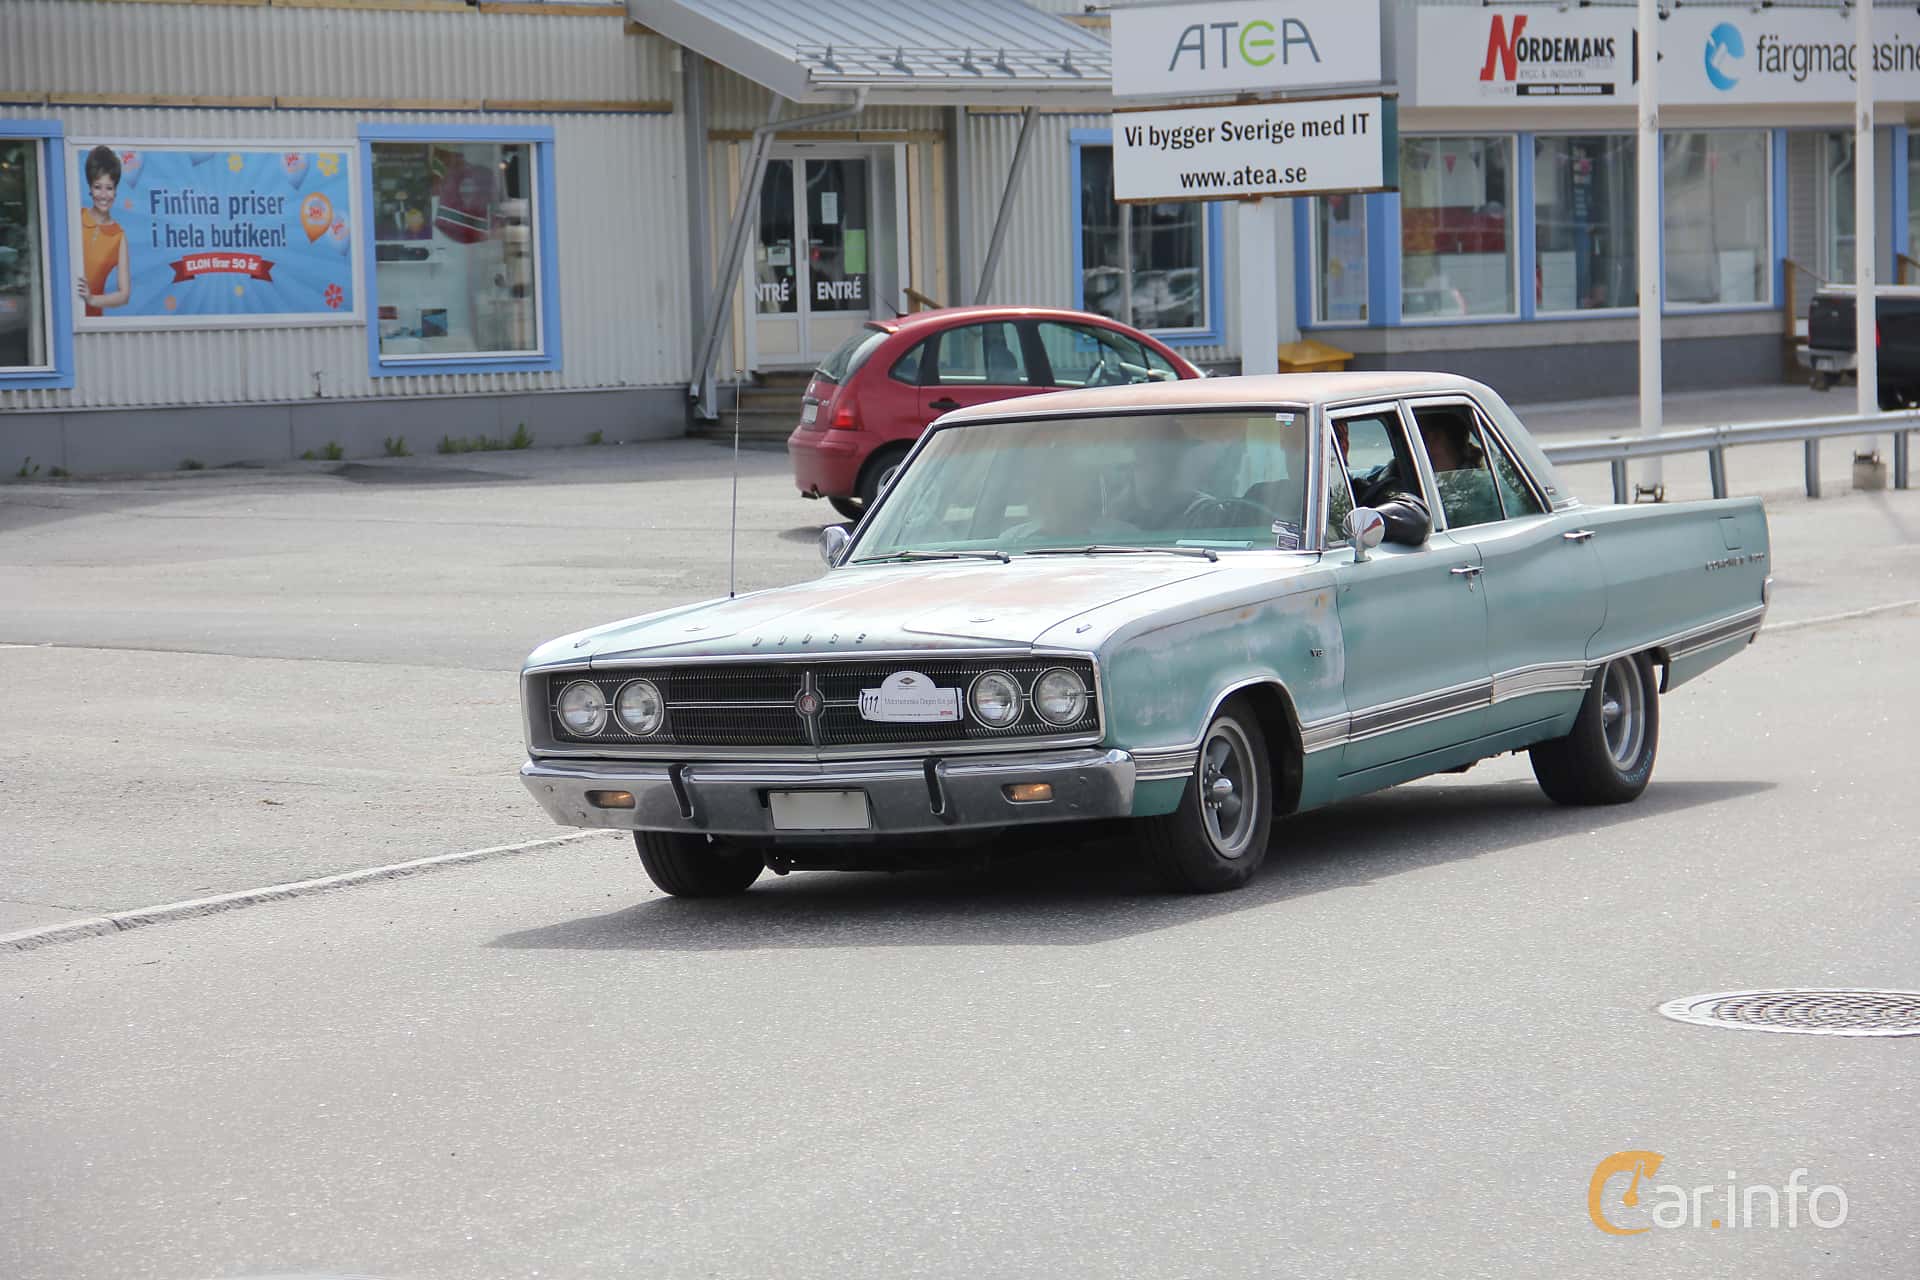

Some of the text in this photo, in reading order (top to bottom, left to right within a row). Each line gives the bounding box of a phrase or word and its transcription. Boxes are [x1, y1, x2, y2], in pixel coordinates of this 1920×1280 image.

[1168, 18, 1321, 72] ATEA
[1480, 14, 1616, 81] NORDEMANS
[1125, 113, 1370, 151] Vi bygger Sverige med IT
[1180, 165, 1308, 189] www.atea.se
[150, 189, 285, 220] Finfina priser
[152, 222, 287, 248] i hela butiken!
[755, 279, 789, 302] NTRÉ
[817, 276, 862, 300] ENTRÉ
